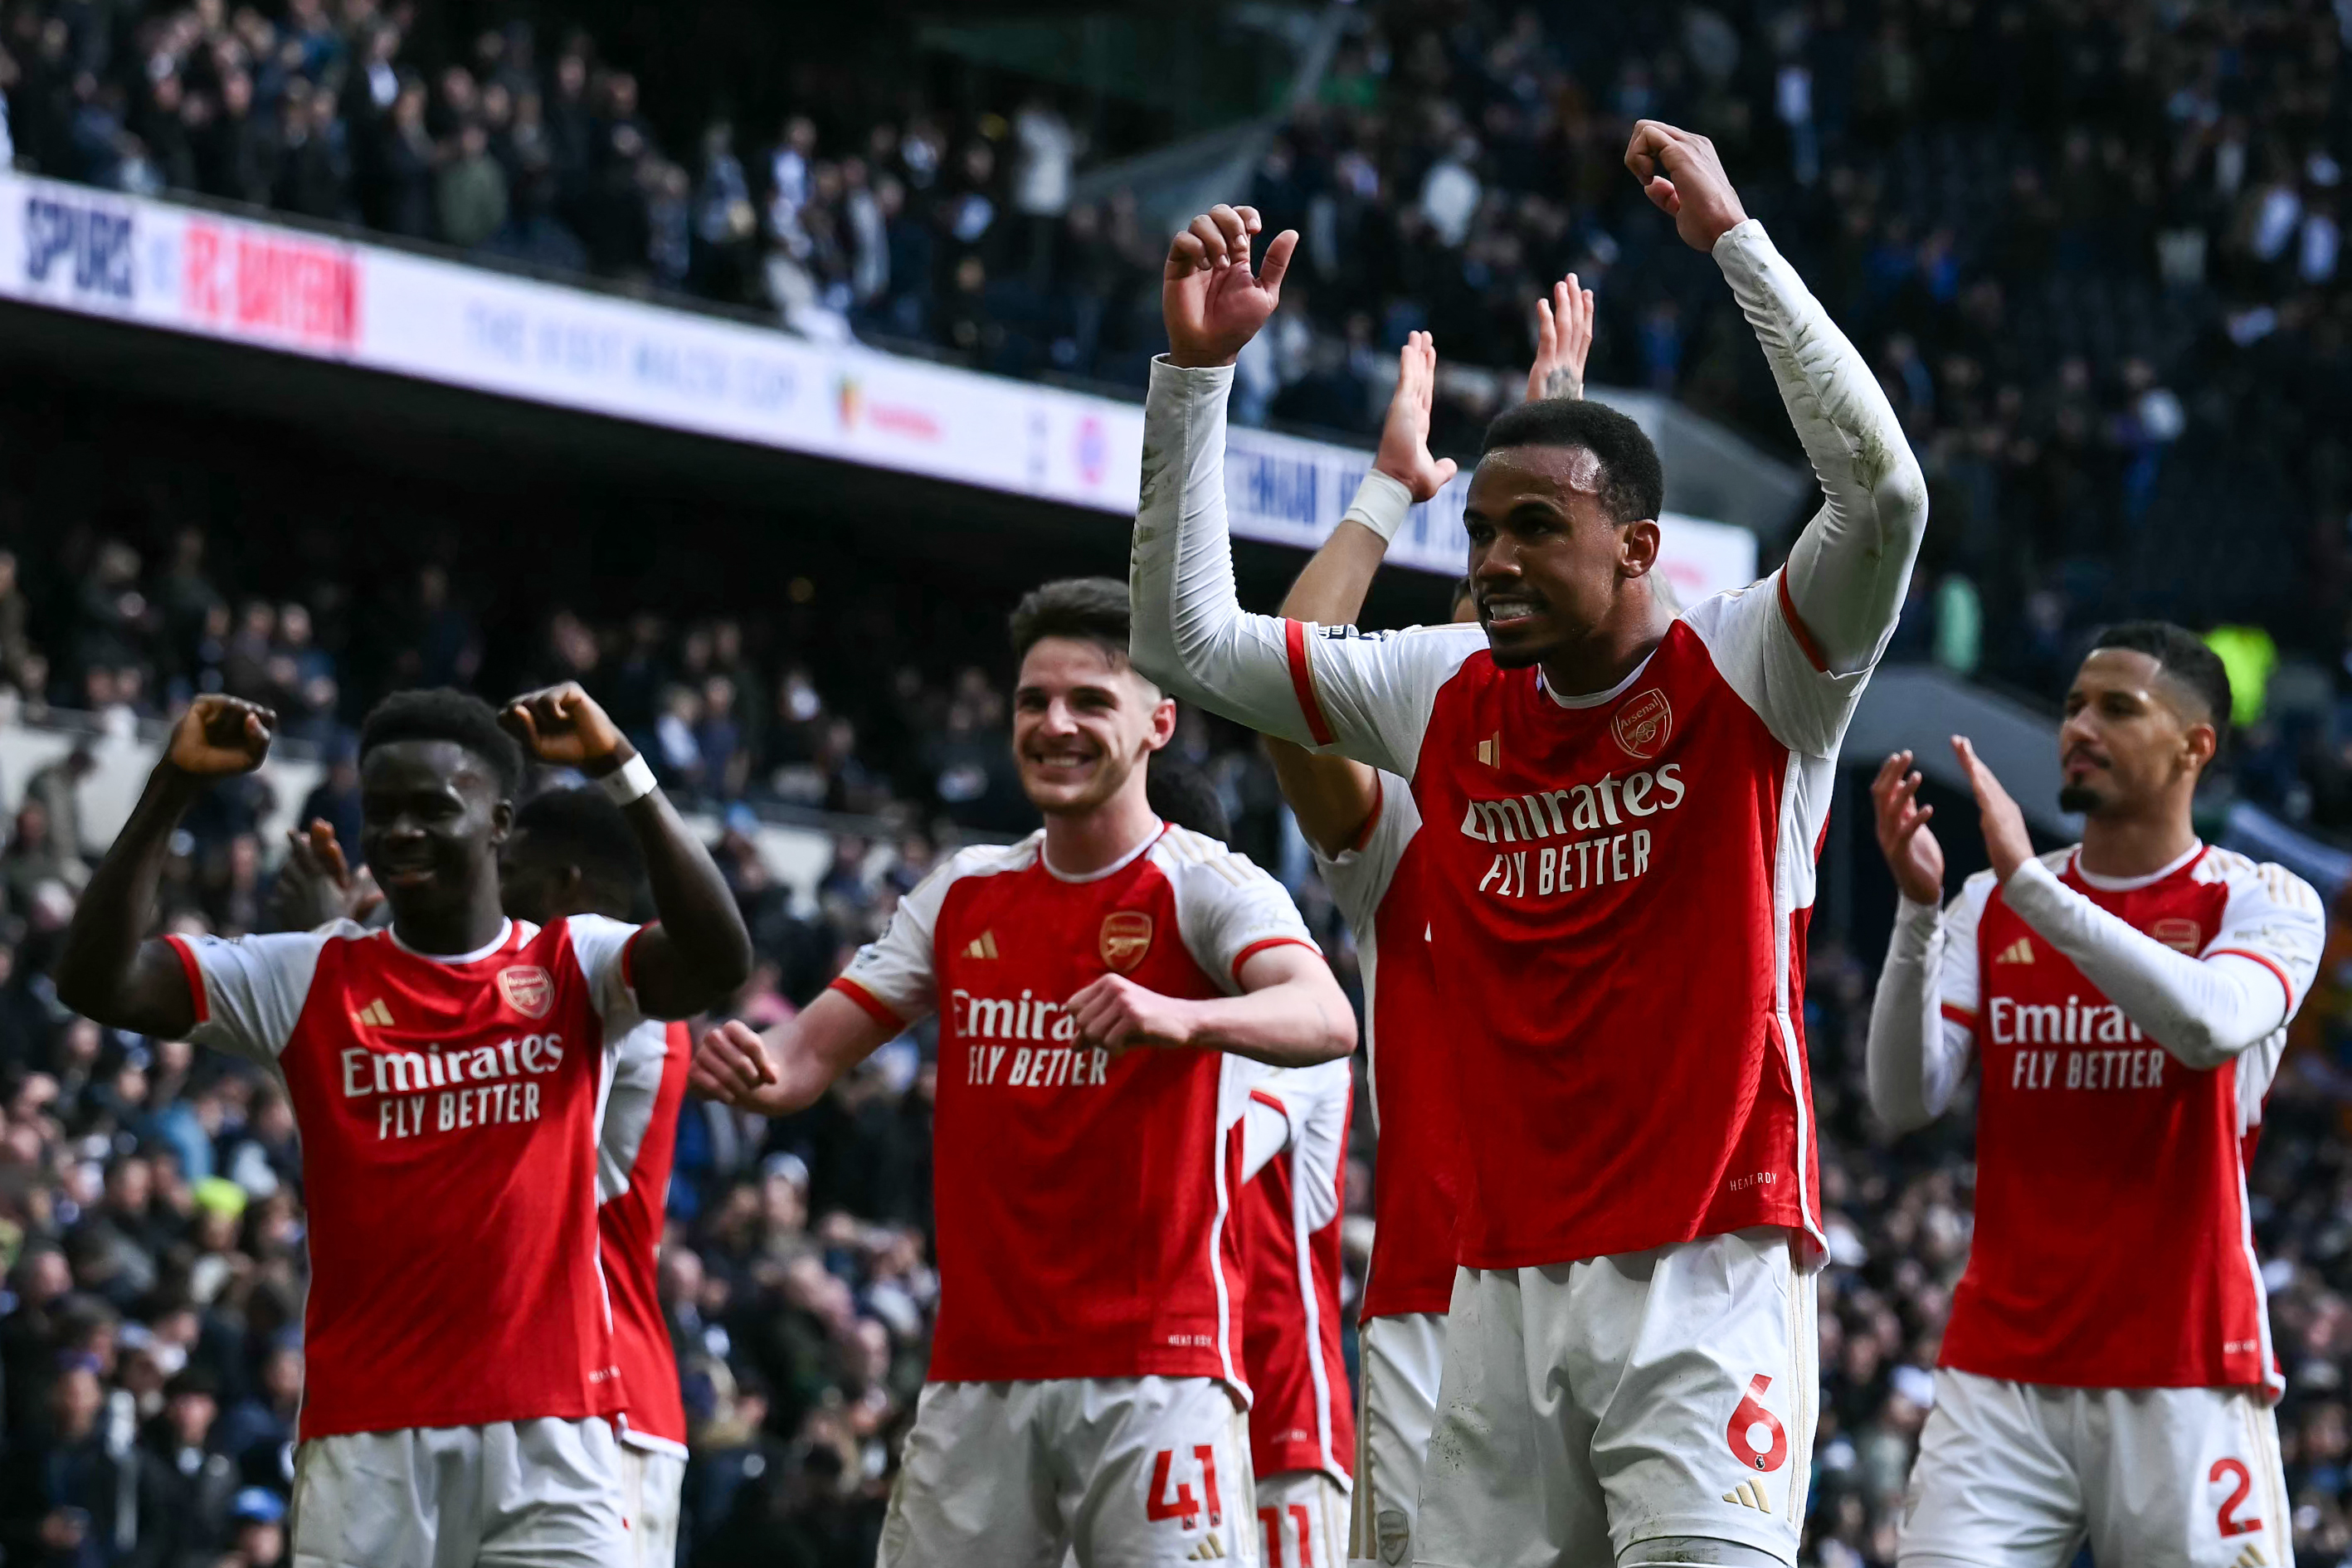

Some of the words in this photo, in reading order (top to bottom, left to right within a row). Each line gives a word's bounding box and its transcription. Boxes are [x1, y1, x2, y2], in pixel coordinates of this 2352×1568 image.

[1620, 699, 1658, 730] Arsenal
[1478, 850, 1527, 898] FLY
[1539, 829, 1651, 896] BETTER
[952, 989, 1075, 1040] Emira
[1989, 995, 2144, 1045] Emira
[341, 1033, 563, 1098] Emirates
[967, 1045, 1006, 1085] FLY
[1008, 1046, 1108, 1087] BETTER
[2012, 1049, 2057, 1089] FLY
[2066, 1049, 2165, 1089] BETTER
[379, 1095, 426, 1141] FLY
[438, 1081, 540, 1132] BETTER
[1726, 1373, 1787, 1473] 6
[1147, 1444, 1222, 1530] 41
[2209, 1458, 2263, 1539] 2
[1258, 1503, 1315, 1568] 11
